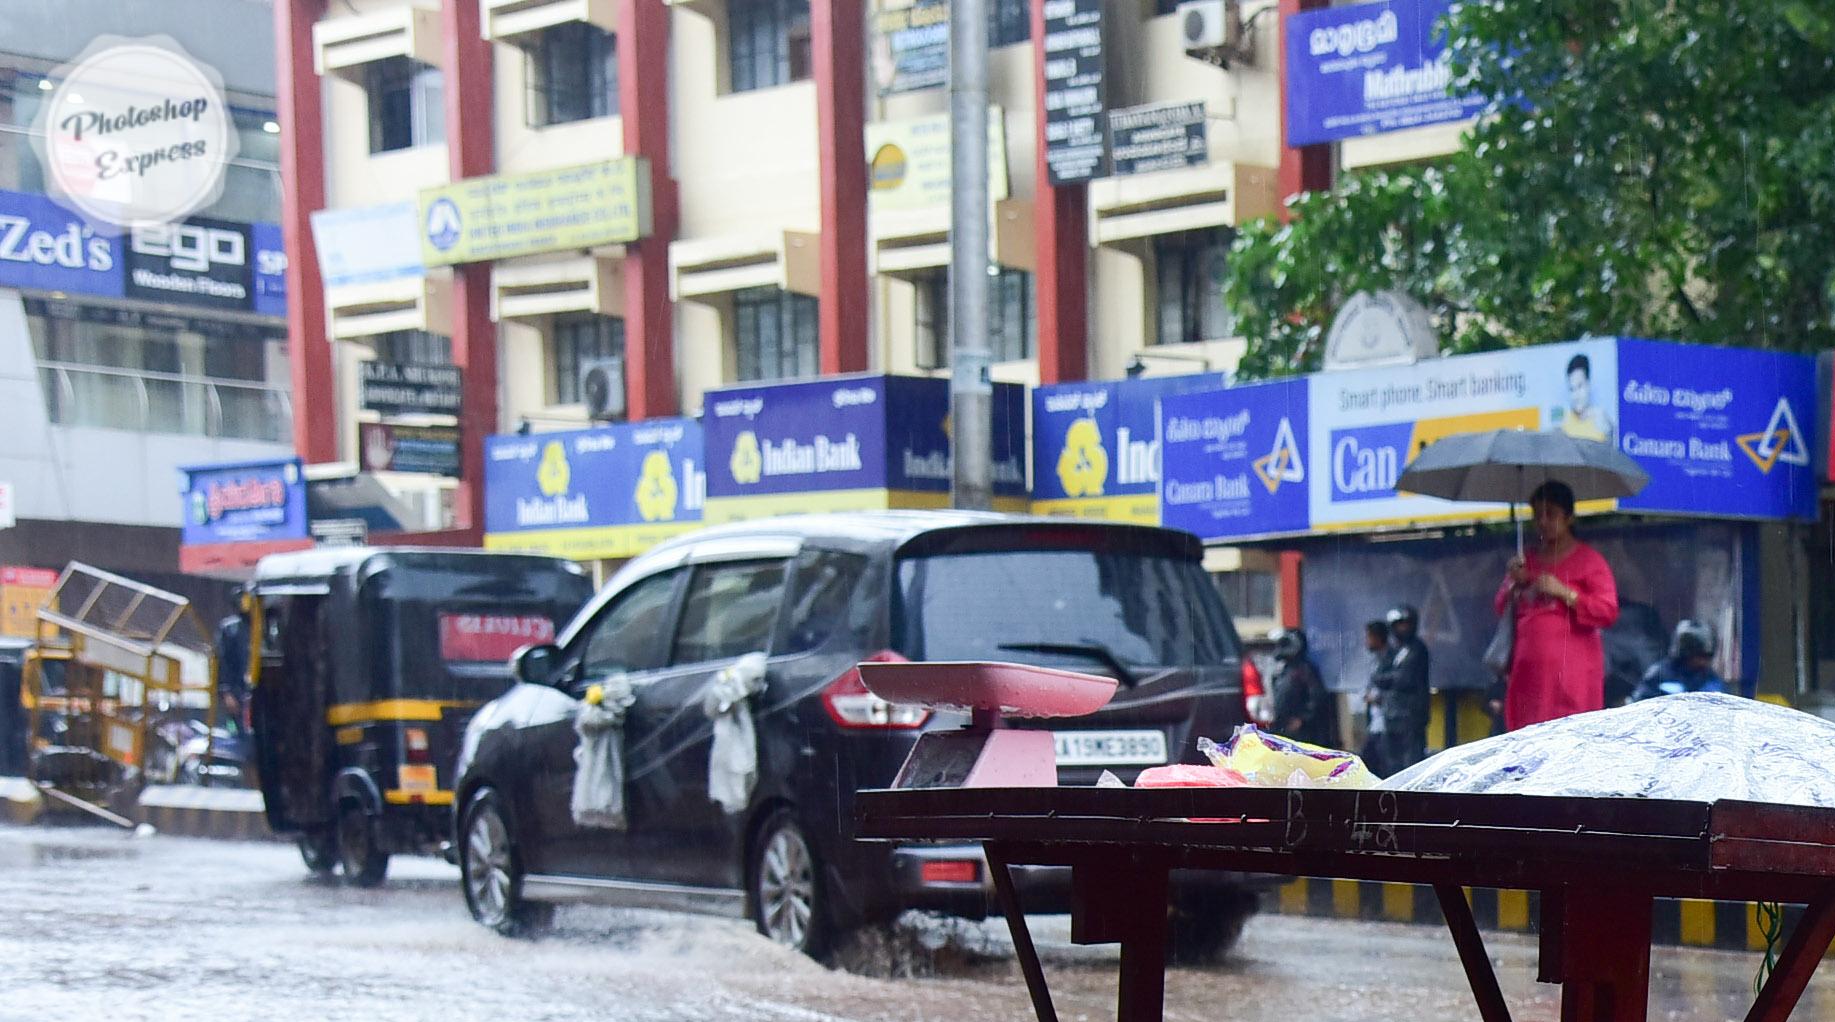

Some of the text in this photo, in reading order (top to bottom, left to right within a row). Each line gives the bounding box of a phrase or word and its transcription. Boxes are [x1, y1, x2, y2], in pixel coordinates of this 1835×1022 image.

[0, 214, 113, 272] Zed's
[131, 220, 246, 272] ego
[1339, 389, 1380, 412] Smart
[1425, 376, 1467, 402] Smart
[763, 432, 862, 475] Indian Bank
[1333, 435, 1397, 493] Can
[1622, 432, 1732, 461] Canara Bank
[1166, 472, 1250, 505] Canara Bank
[517, 493, 589, 526] Indian Bank
